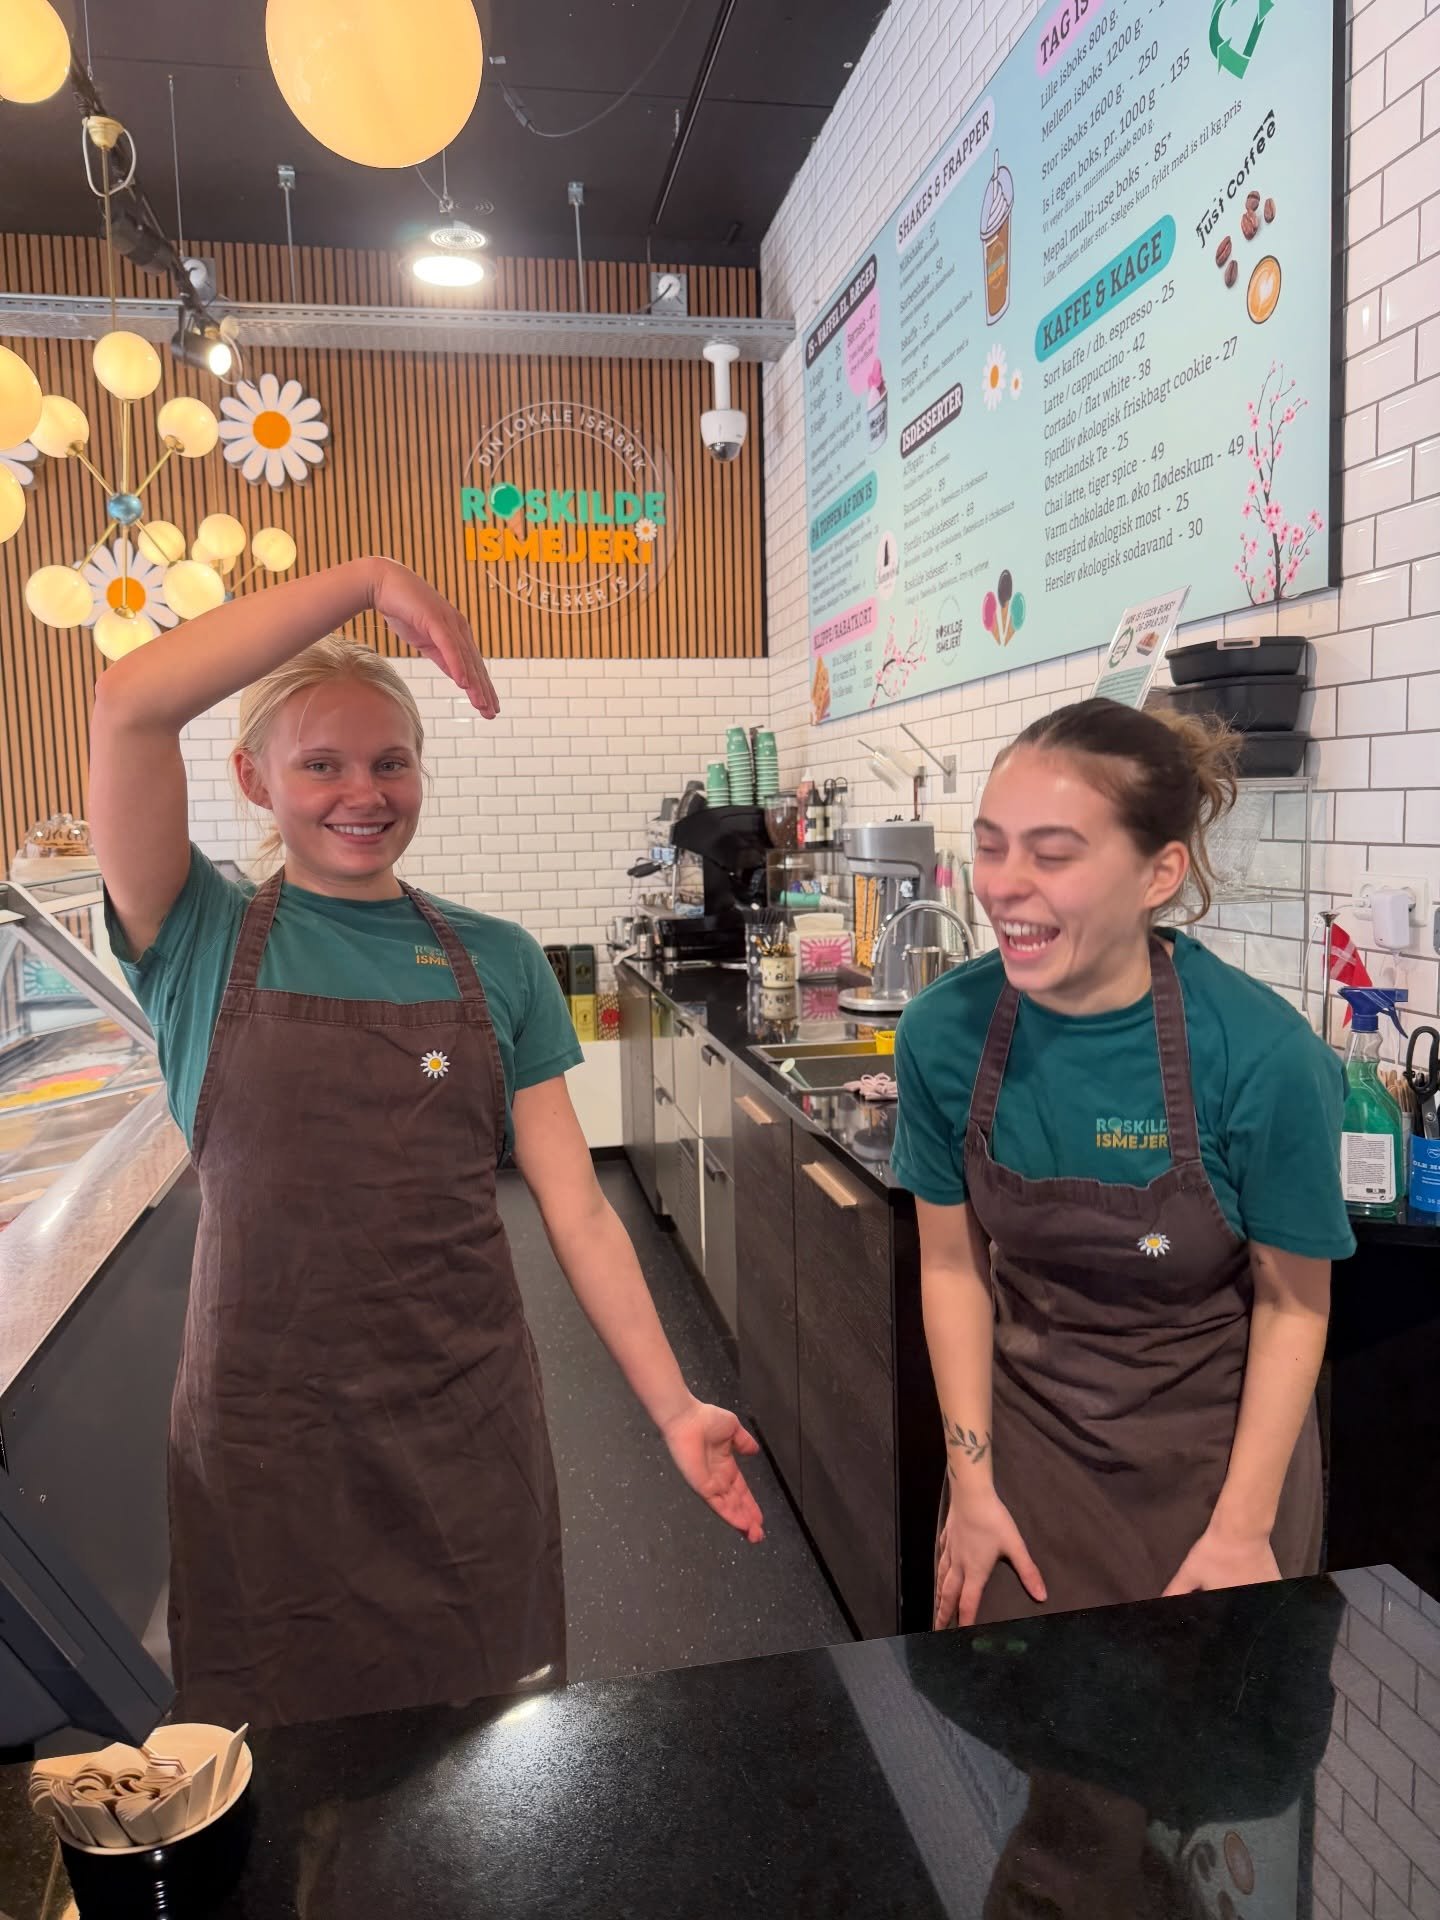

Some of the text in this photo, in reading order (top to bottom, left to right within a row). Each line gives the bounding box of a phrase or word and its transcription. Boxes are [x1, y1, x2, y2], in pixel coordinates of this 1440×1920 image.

[1041, 8, 1071, 65] TAG
[1041, 8, 1118, 110] Lille isboks 800 g.
[1042, 98, 1072, 142] Mellem
[1074, 62, 1103, 105] isboks
[1107, 25, 1131, 66] 1200
[1134, 18, 1143, 41] g.
[1042, 152, 1059, 180] Stor
[1061, 121, 1088, 160] isboks
[1090, 89, 1114, 128] 1600
[1115, 83, 1124, 105] g.
[1138, 40, 1158, 76] 250
[1042, 198, 1050, 215] Is
[1051, 189, 1054, 205] i
[1056, 171, 1076, 201] egen
[1078, 147, 1102, 178] boks,
[1104, 129, 1117, 157] pr.
[1120, 95, 1146, 135] 1000
[1148, 88, 1155, 111] g
[1170, 48, 1190, 83] 135
[899, 185, 932, 244] SHAKES
[935, 175, 940, 197] &
[943, 110, 989, 187] FRAPPER
[1043, 229, 1068, 267] Mepal
[1070, 190, 1114, 242] multi-use
[1116, 166, 1140, 198] boks
[1042, 289, 1091, 353] KAFFE
[1096, 278, 1106, 308] &
[1110, 229, 1162, 298] KAGE
[1044, 366, 1060, 389] Sort
[1062, 347, 1085, 376] kaffe
[1093, 332, 1108, 353] db.
[1109, 300, 1152, 341] espresso
[1162, 280, 1174, 304] 25
[1044, 392, 1064, 415] Latte
[1072, 350, 1124, 395] cappuccino
[1132, 332, 1145, 352] 42
[902, 386, 961, 452] ISDESSERTER
[1044, 408, 1077, 440] Cortado
[1085, 392, 1101, 415] flat
[1102, 375, 1130, 403] white
[1138, 358, 1151, 381] 38
[1044, 436, 1076, 468] Fjordliv
[1077, 407, 1121, 447] økologisk
[1123, 378, 1171, 419] friskbagt
[1173, 354, 1212, 389] cookie
[1223, 336, 1238, 361] 27
[478, 409, 647, 472] DIN LOKALE ISFABRIK
[1045, 450, 1095, 491] Østerlandsk
[1096, 445, 1108, 463] Te
[1117, 431, 1129, 452] 25
[1045, 493, 1063, 517] Chai
[1064, 487, 1086, 507] latte,
[1088, 473, 1110, 496] tiger
[1112, 459, 1137, 485] spice
[1151, 442, 1164, 462] 49
[461, 482, 667, 526] ROSKILDE
[1045, 522, 1067, 541] Varm
[1069, 497, 1115, 531] chokolade
[1116, 494, 1129, 509] m.
[1131, 482, 1149, 503] øko
[1153, 453, 1214, 493] flødeskum
[1228, 434, 1244, 456] 49
[1045, 535, 1086, 568] Østergård
[1088, 515, 1131, 550] økologisk
[1135, 505, 1161, 530] most
[1176, 491, 1189, 512] 25
[1045, 570, 1076, 592] Herslev
[1077, 549, 1121, 581] økologisk
[1123, 528, 1173, 563] sodavand
[1188, 518, 1203, 539] 30
[516, 576, 628, 608] VI ELSKER IS
[1096, 1133, 1168, 1149] ISMEJER
